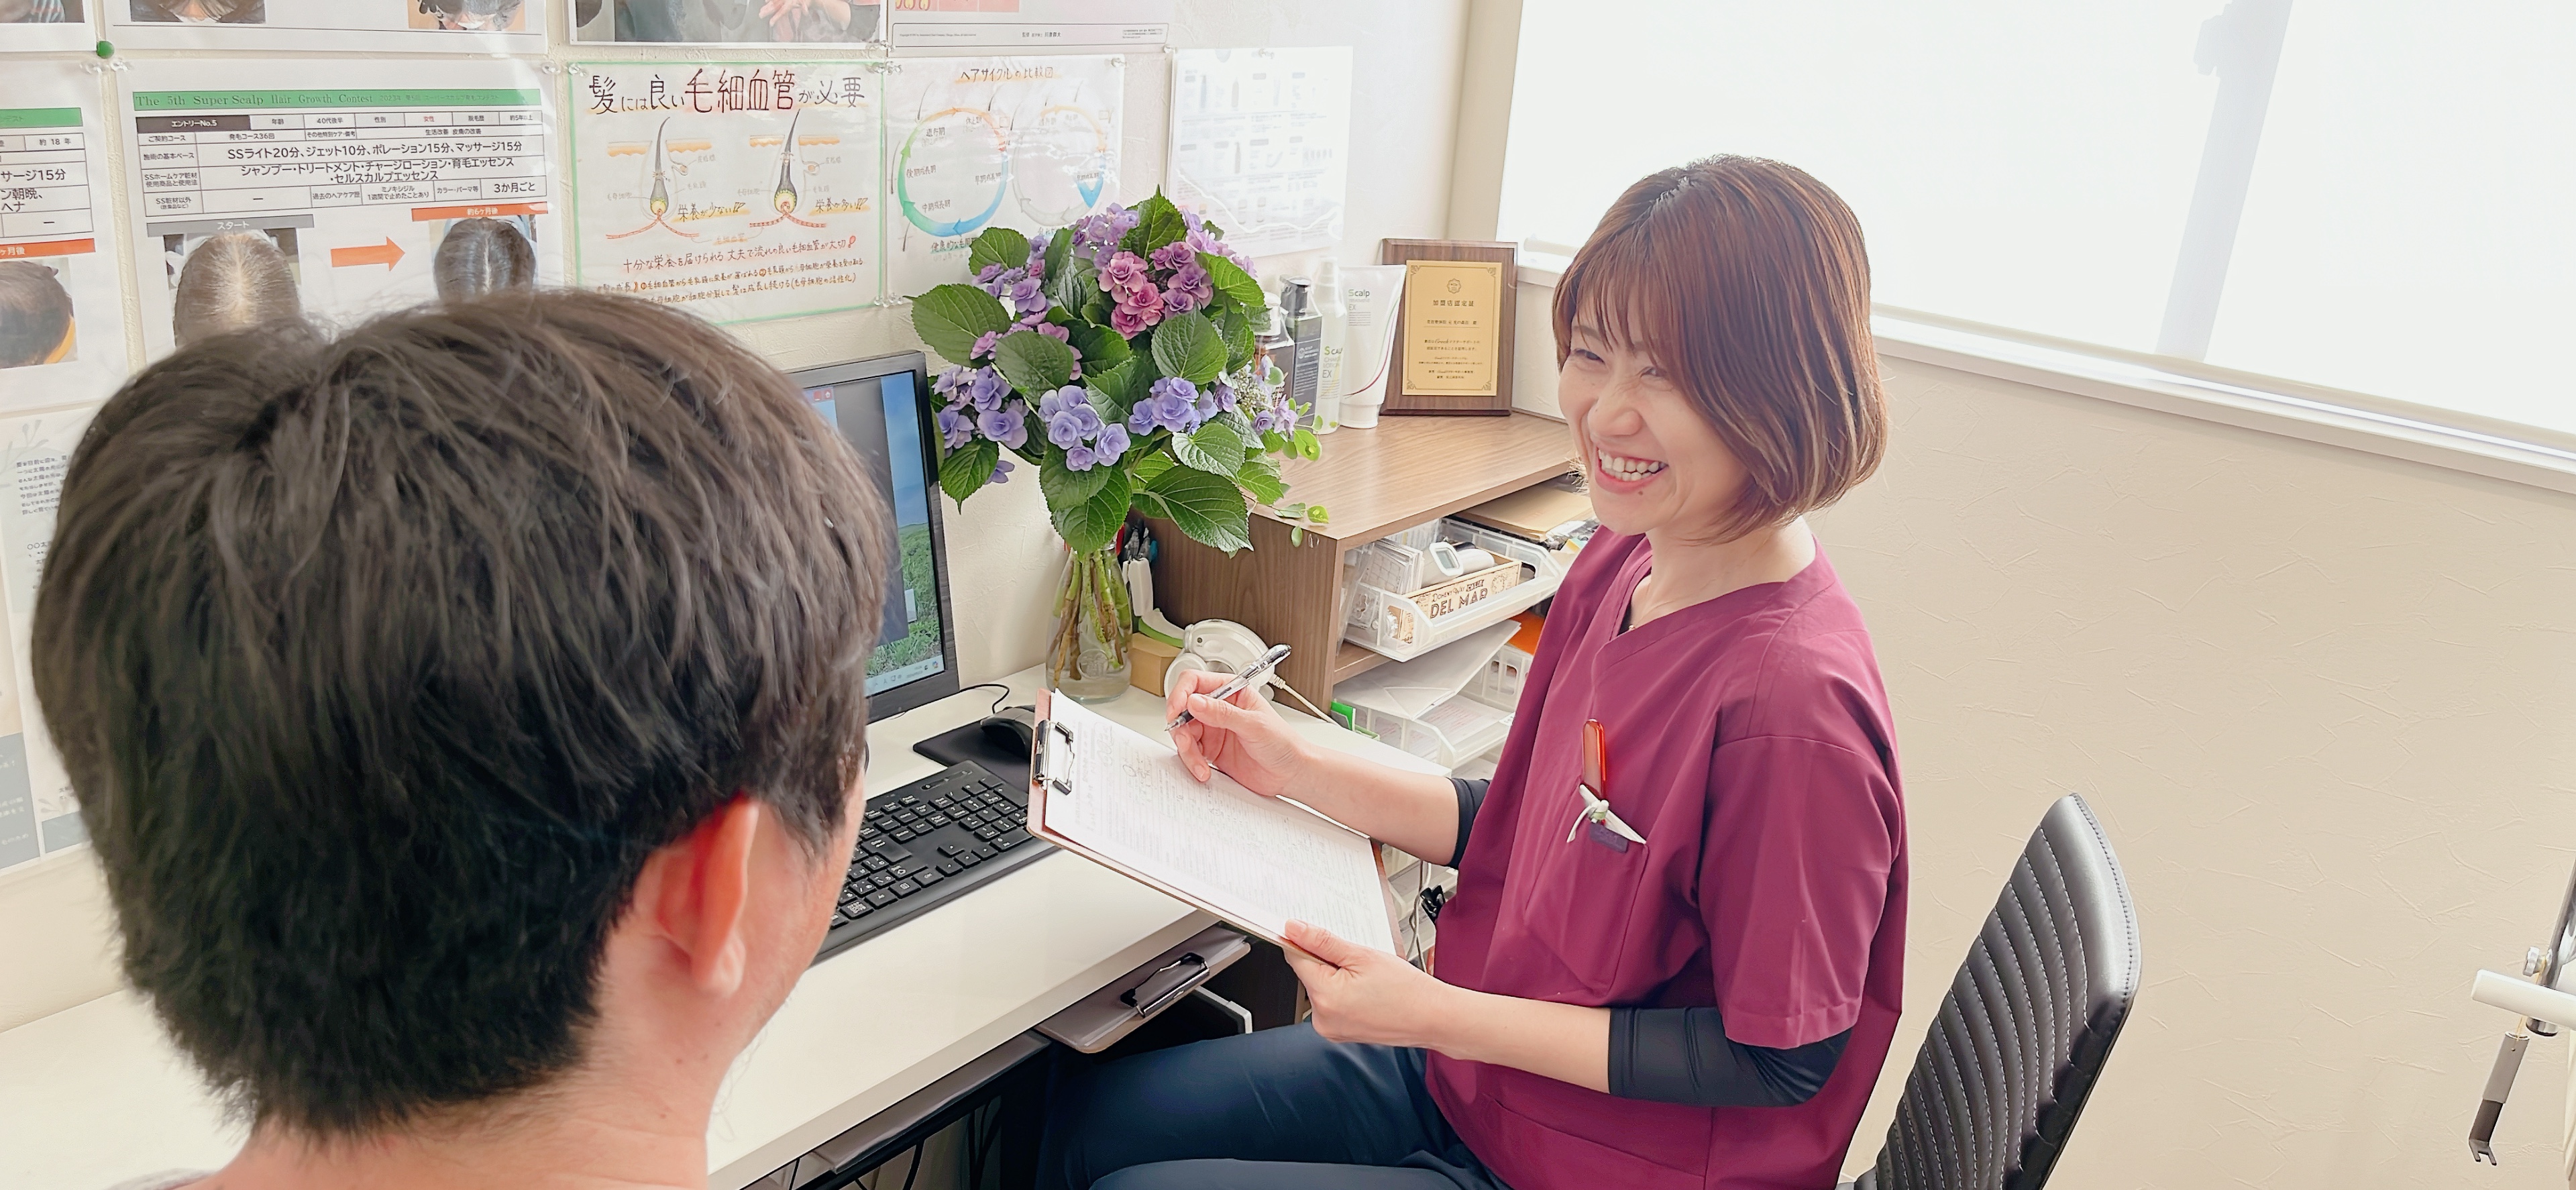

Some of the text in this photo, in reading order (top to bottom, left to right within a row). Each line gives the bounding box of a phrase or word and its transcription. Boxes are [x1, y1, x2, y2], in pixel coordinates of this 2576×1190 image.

[589, 68, 865, 115] 髪には良い毛細血管が必要
[136, 94, 372, 106] The 5th Super Scalp Hair Growth Contest
[171, 119, 218, 127] エントリーNo.5
[0, 168, 66, 182] サージ15分
[494, 182, 535, 193] 3か月ごと
[1, 201, 25, 213] ヘナ
[217, 221, 250, 230] スタート
[1348, 288, 1370, 298] Scalp
[1322, 370, 1332, 378] EX
[1430, 588, 1488, 618] DEL MAR
